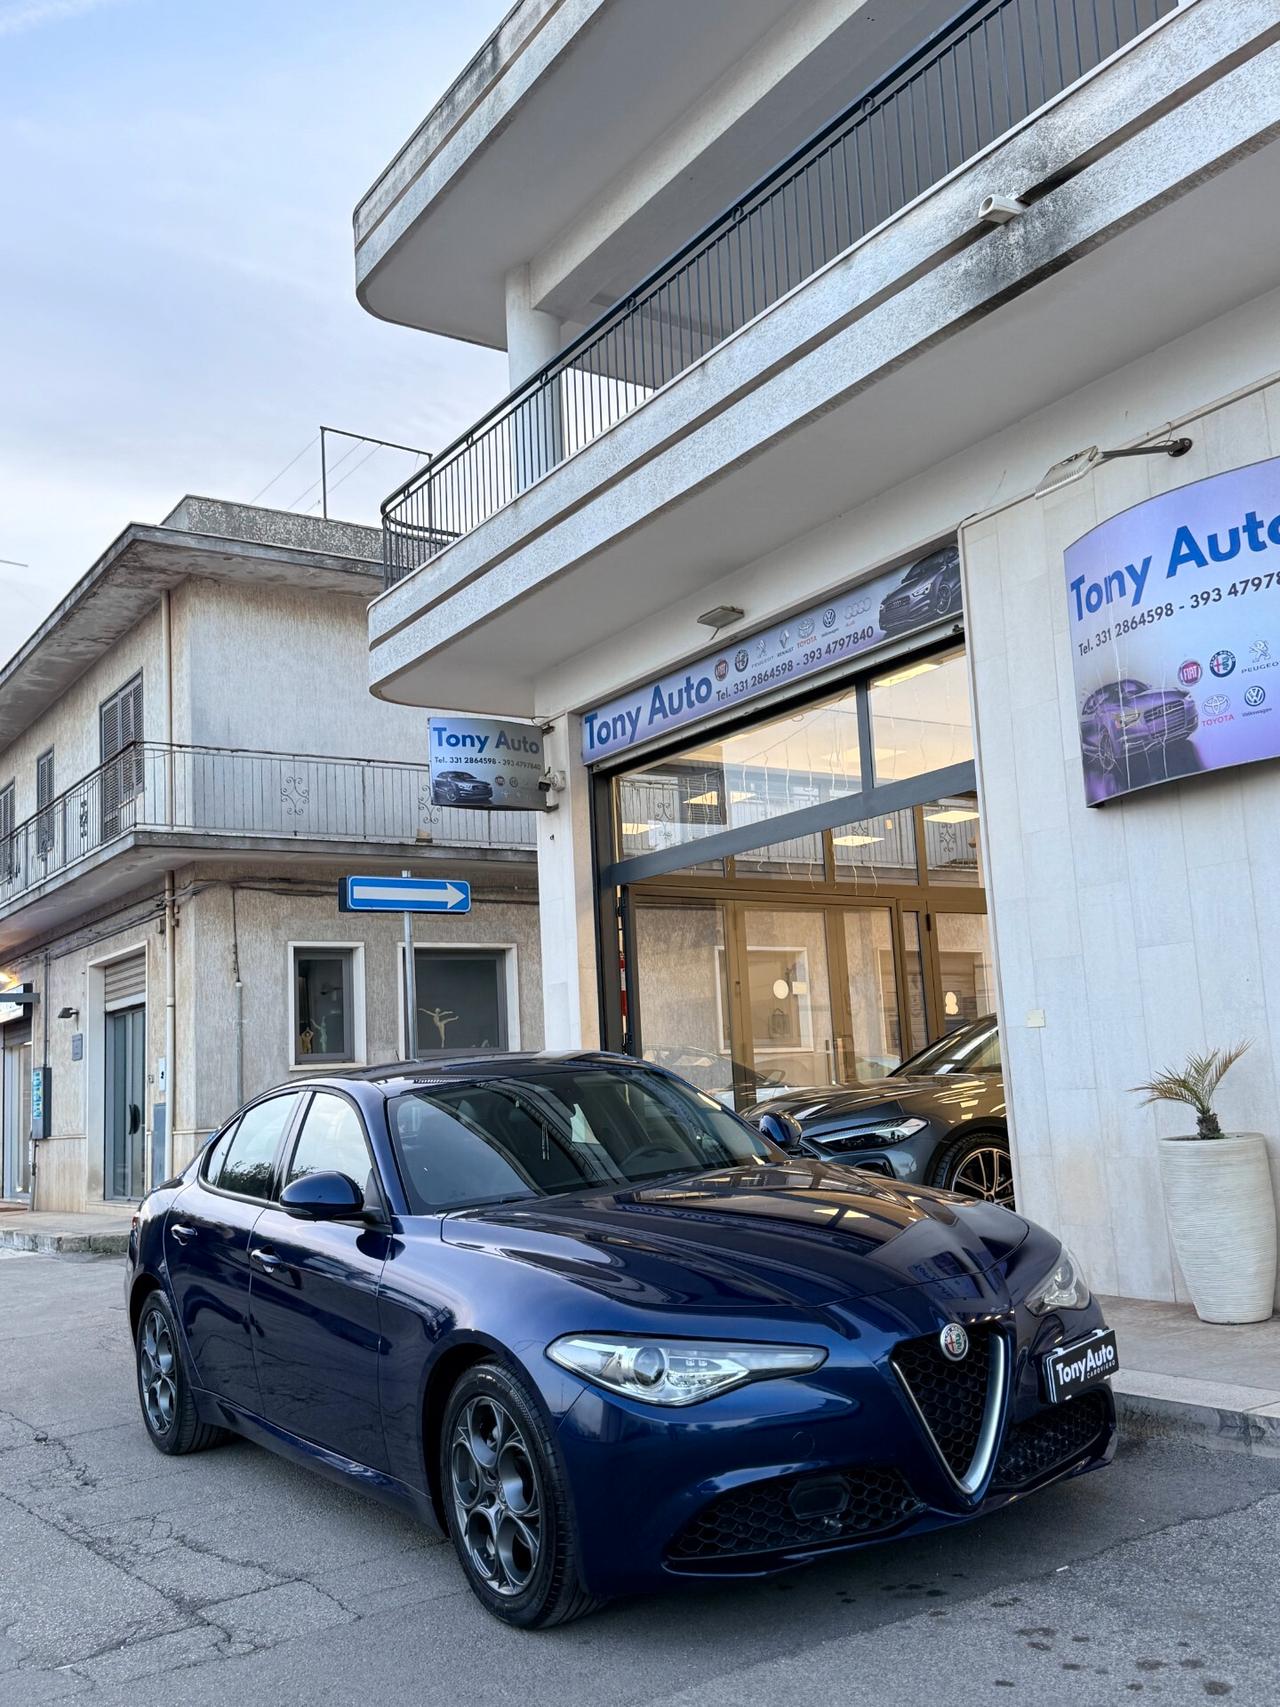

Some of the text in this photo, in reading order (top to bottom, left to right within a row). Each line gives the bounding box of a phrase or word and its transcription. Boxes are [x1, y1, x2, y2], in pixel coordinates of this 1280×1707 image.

[1070, 555, 1152, 622] Tony
[1078, 642, 1093, 656] Tel.
[1095, 628, 1112, 647] 331
[1115, 602, 1174, 638] 2864598
[1190, 587, 1222, 609] 393
[716, 687, 731, 702] Tel.
[733, 679, 749, 695] 331
[751, 661, 794, 687] 2864598
[803, 650, 822, 665] 393
[824, 625, 874, 656] 4797840
[1241, 660, 1280, 674] PEUGEO
[584, 676, 712, 750] Tony Auto
[1202, 714, 1235, 727] TOYOTA
[432, 727, 540, 754] Tony Auto
[464, 757, 497, 765] 2864598
[1056, 1344, 1114, 1385] TonyAuto
